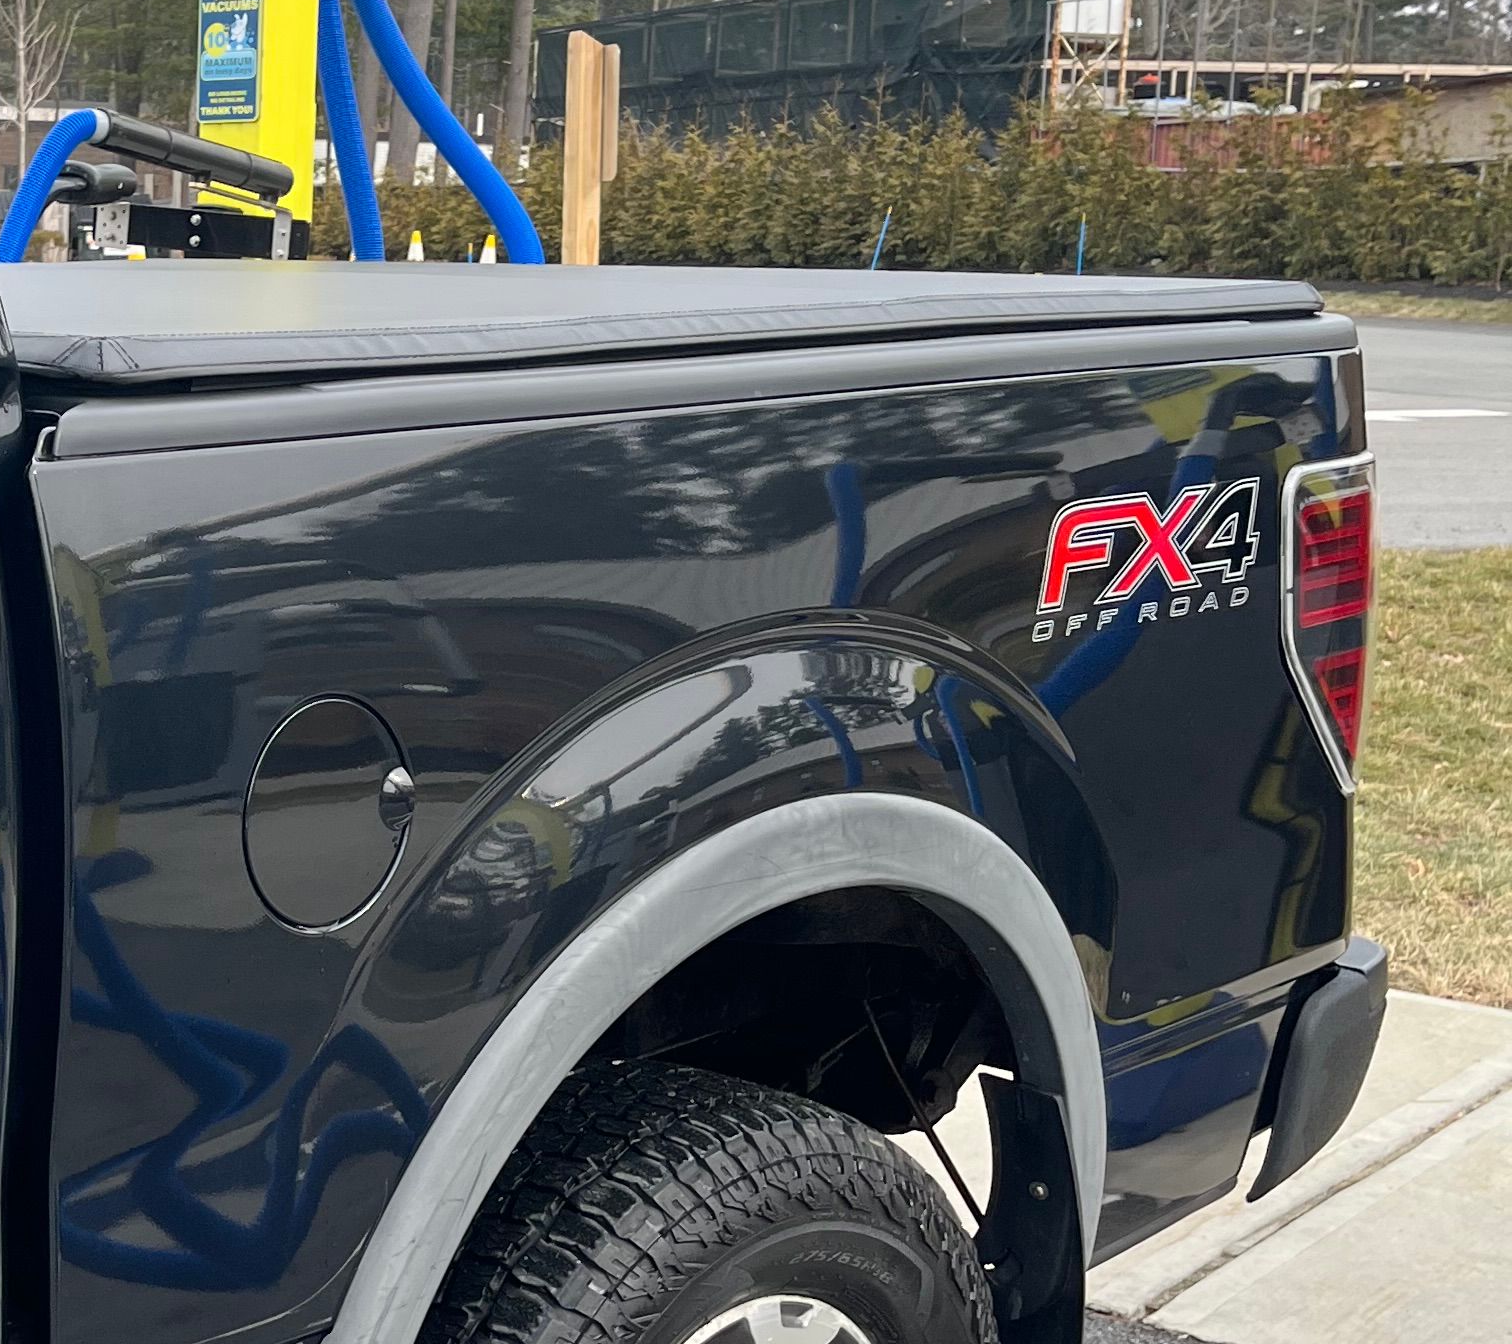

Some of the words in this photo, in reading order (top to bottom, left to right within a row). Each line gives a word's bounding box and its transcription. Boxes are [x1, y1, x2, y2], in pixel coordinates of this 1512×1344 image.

[202, 0, 259, 13] VACUUMS
[208, 31, 226, 48] 10
[205, 57, 253, 68] MAXIMUM
[200, 106, 231, 116] THANK
[1036, 477, 1260, 615] FX4
[1031, 608, 1118, 643] OFF
[1138, 586, 1251, 624] ROAD
